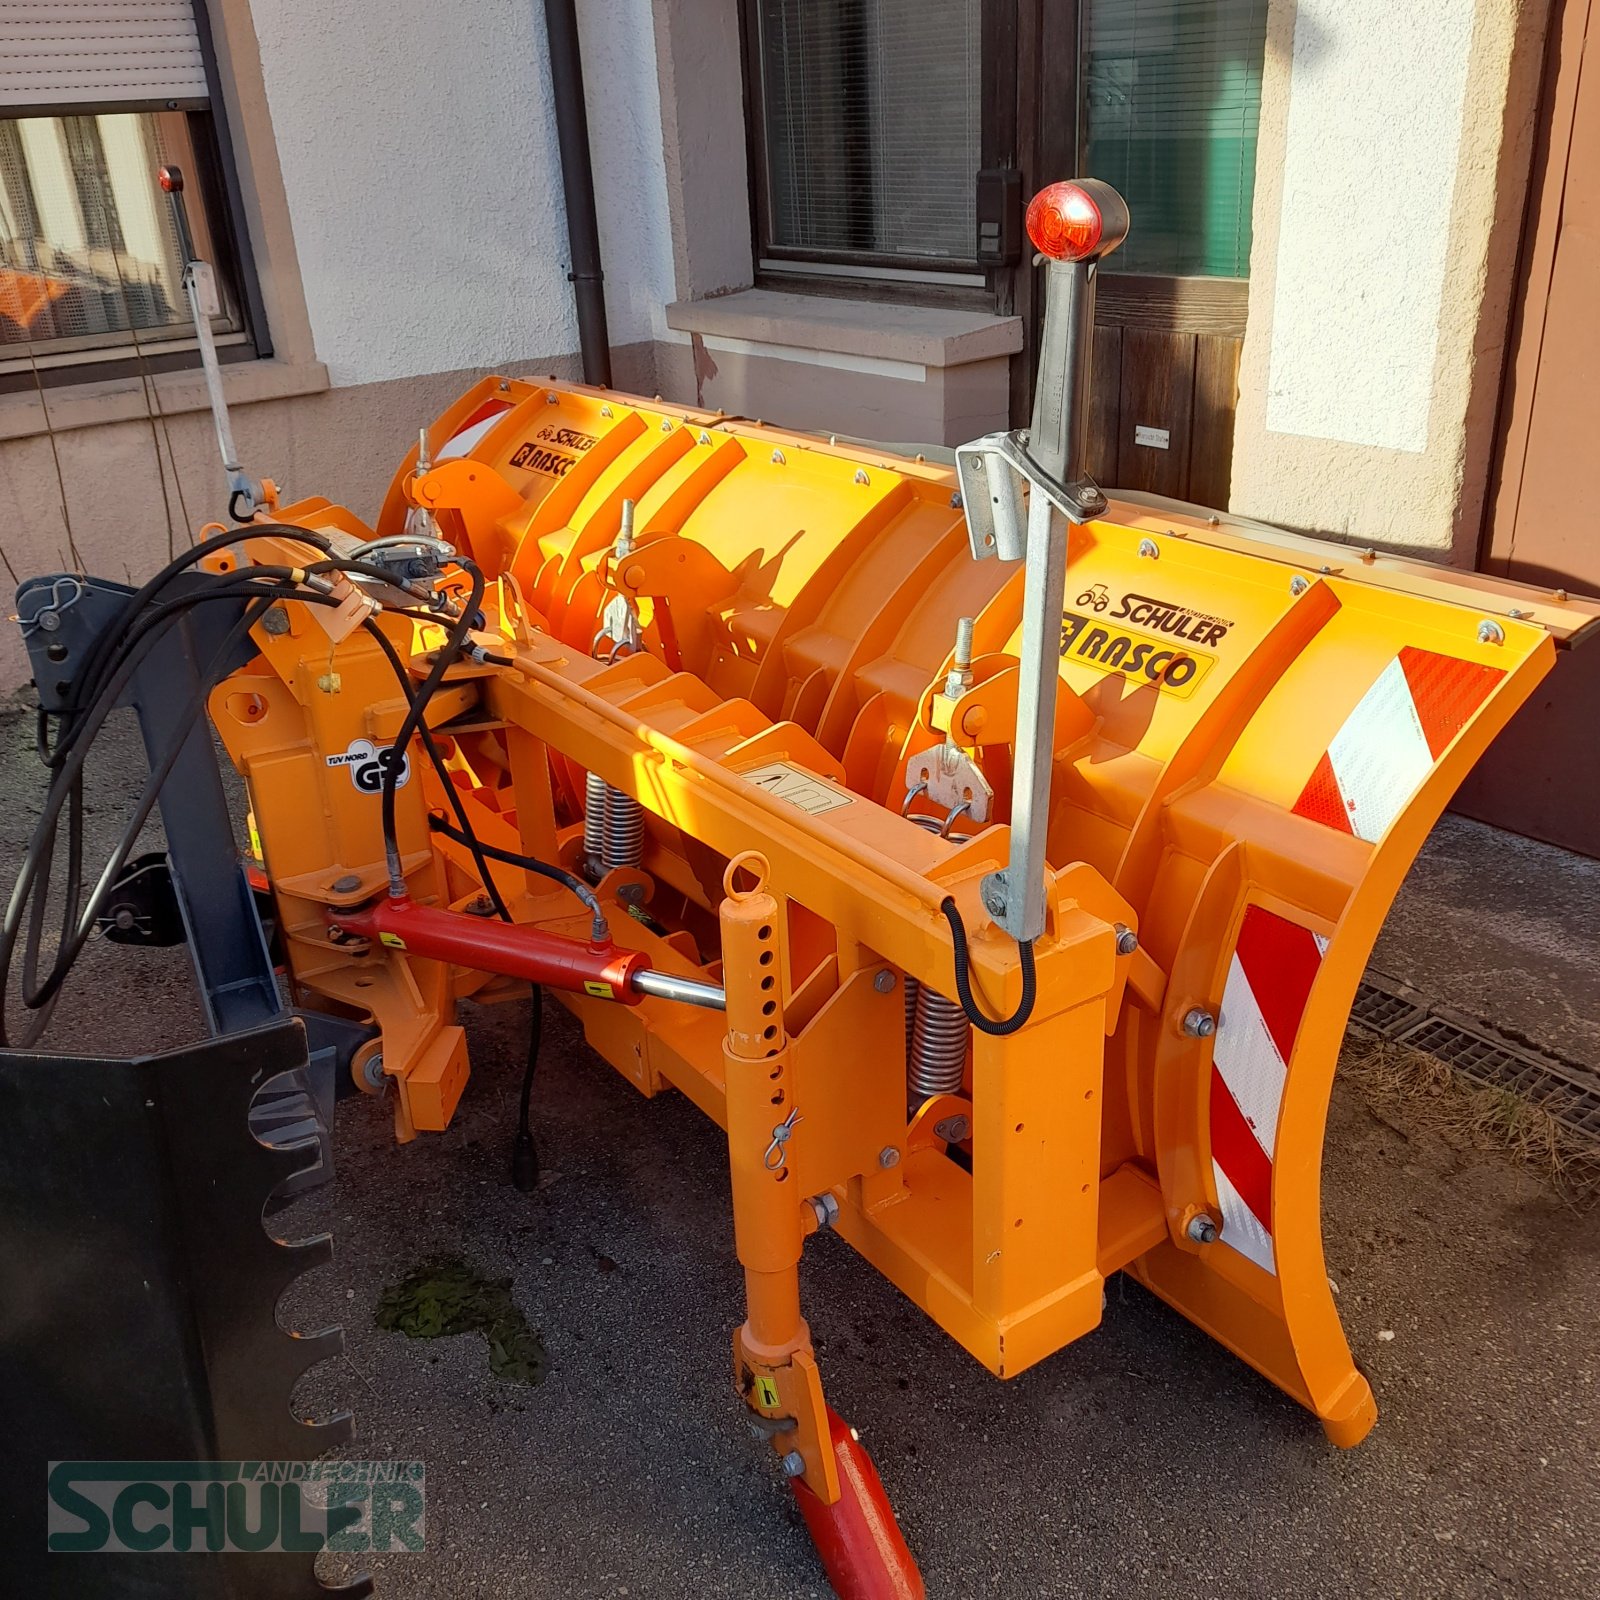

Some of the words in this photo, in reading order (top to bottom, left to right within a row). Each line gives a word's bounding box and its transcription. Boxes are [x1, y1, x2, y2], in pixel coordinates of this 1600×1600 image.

[1109, 593, 1228, 648] SCHULER
[1076, 628, 1197, 687] RASCO
[328, 756, 344, 765] TÜV
[344, 752, 368, 763] NORD
